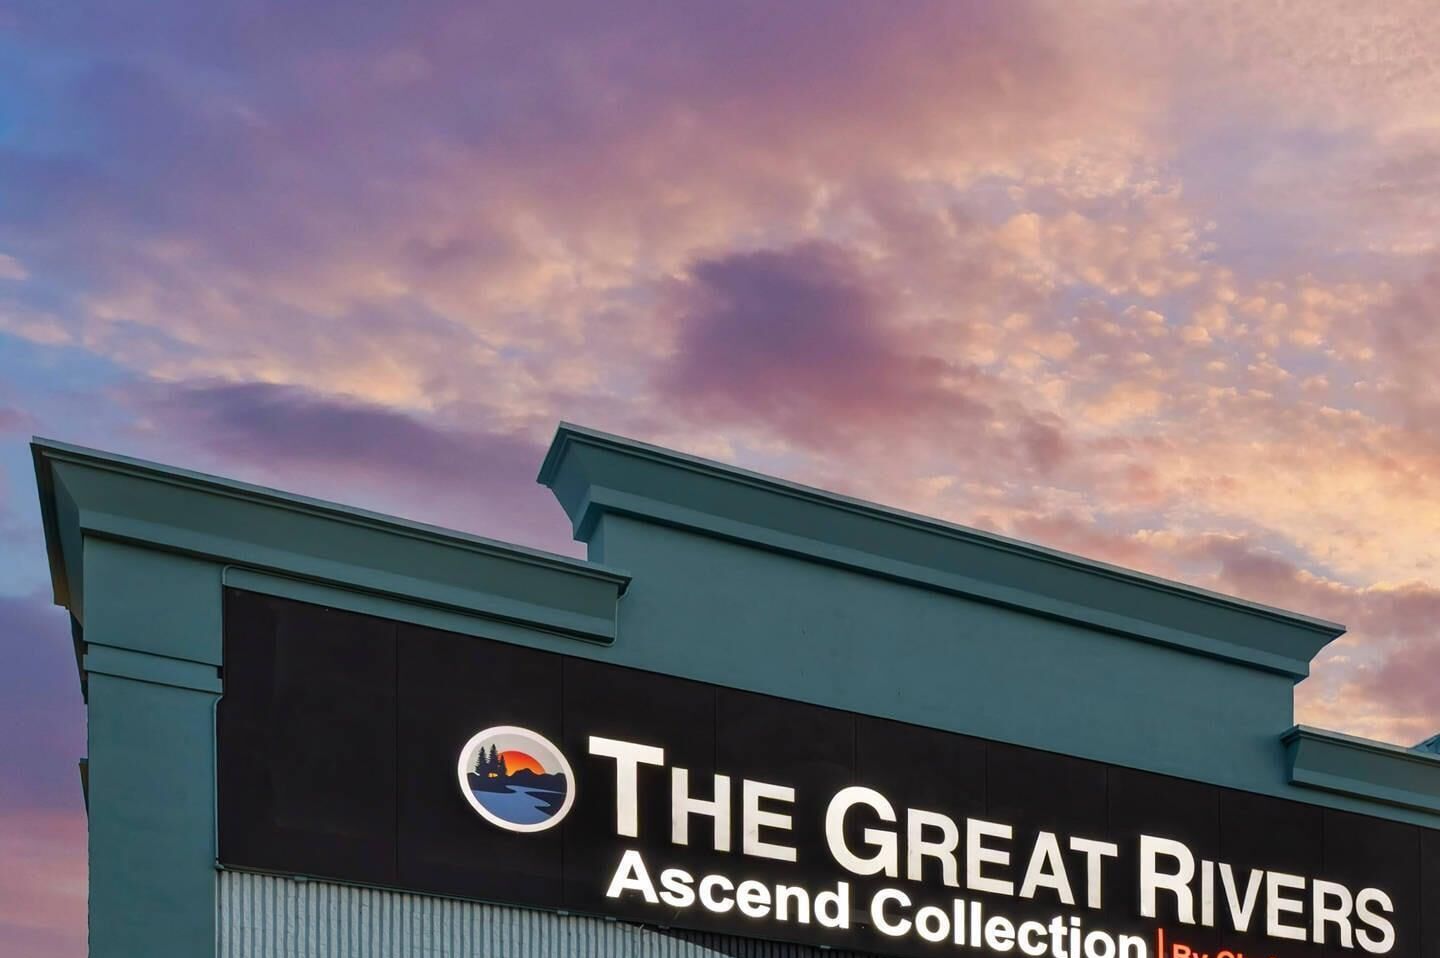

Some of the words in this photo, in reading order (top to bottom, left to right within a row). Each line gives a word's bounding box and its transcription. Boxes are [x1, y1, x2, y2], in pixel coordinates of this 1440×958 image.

[588, 735, 797, 863] THE
[825, 785, 1118, 909] GREAT
[1139, 834, 1396, 955] RIVERS
[605, 849, 850, 930] Ascend
